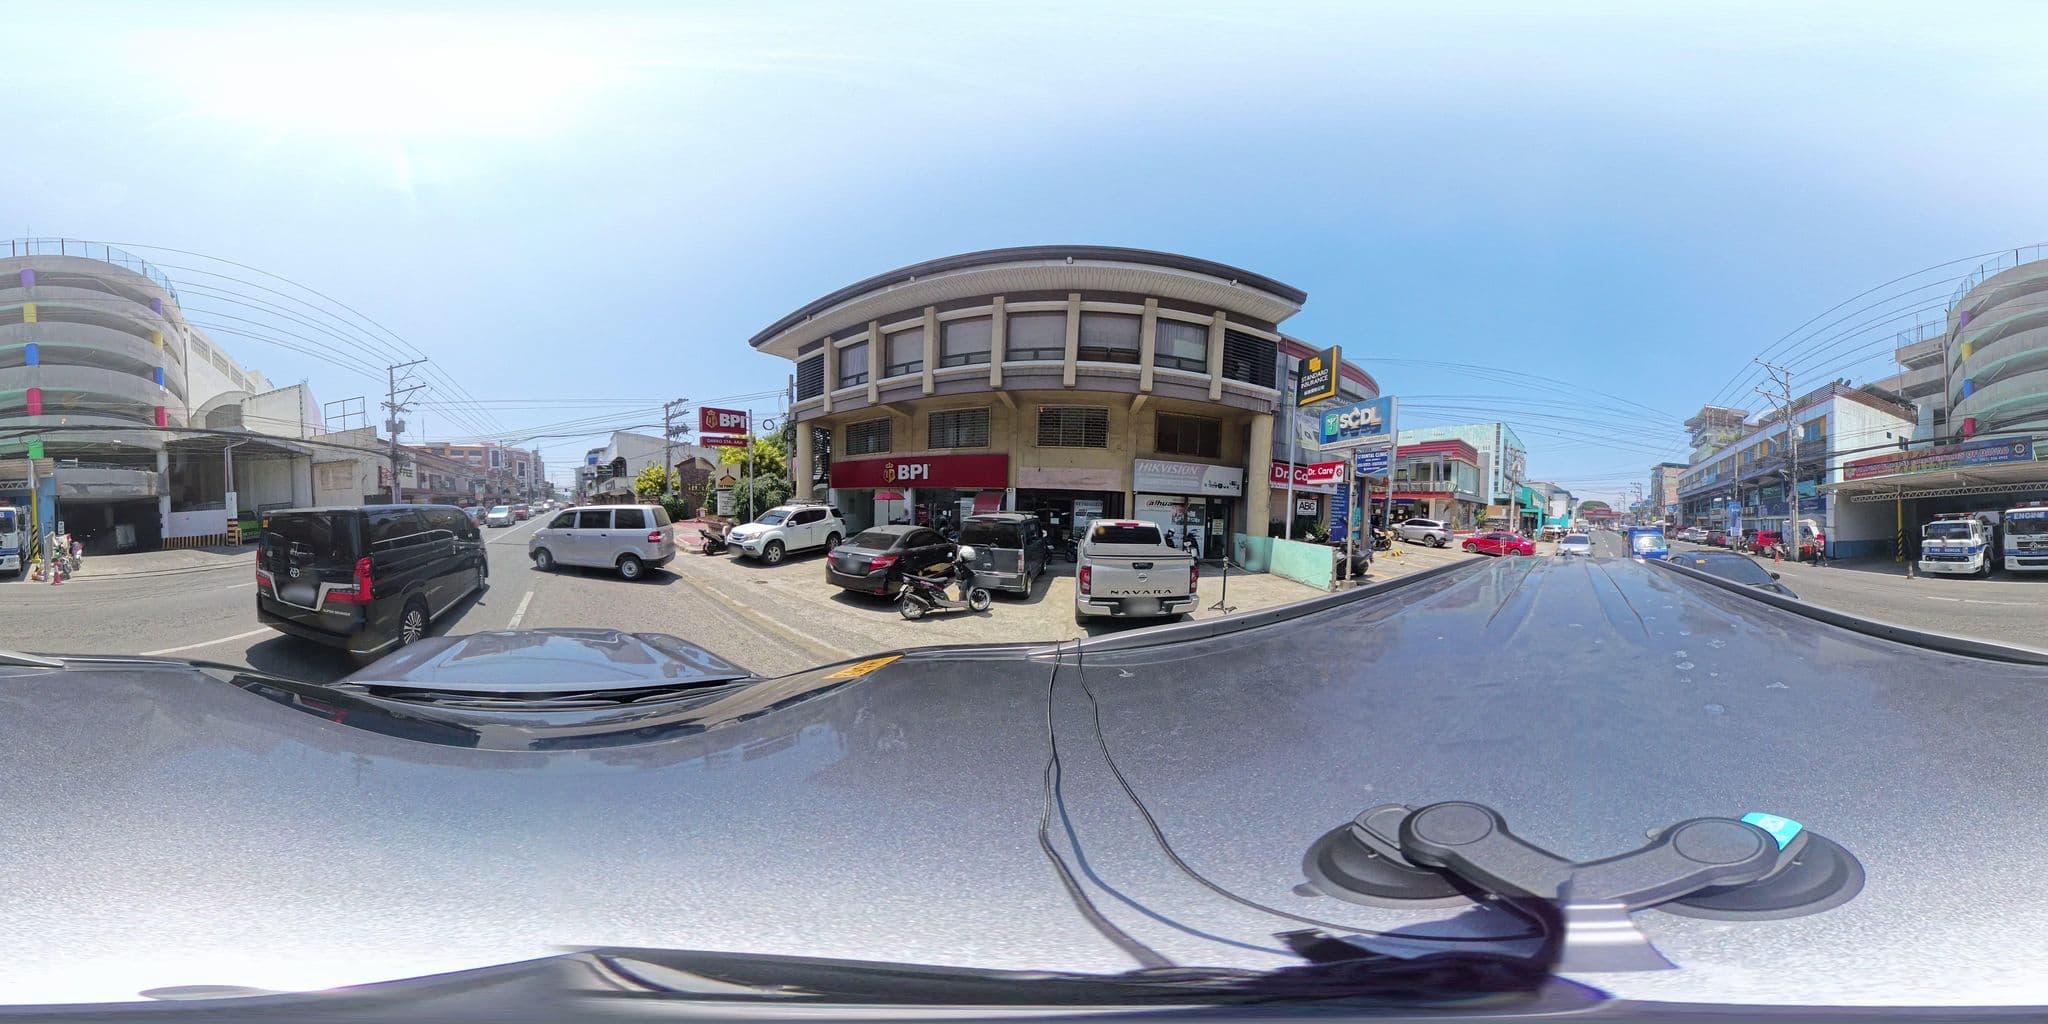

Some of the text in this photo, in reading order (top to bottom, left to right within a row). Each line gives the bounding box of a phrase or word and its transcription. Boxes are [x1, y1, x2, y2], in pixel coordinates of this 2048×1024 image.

[1301, 369, 1329, 382] STANDARD
[1301, 375, 1329, 389] INSURANCE
[719, 413, 745, 429] BPI
[1340, 407, 1382, 429] SCDL
[897, 464, 929, 480] BPI
[1139, 463, 1200, 475] HIKVISION
[1308, 467, 1334, 476] Dr. Care
